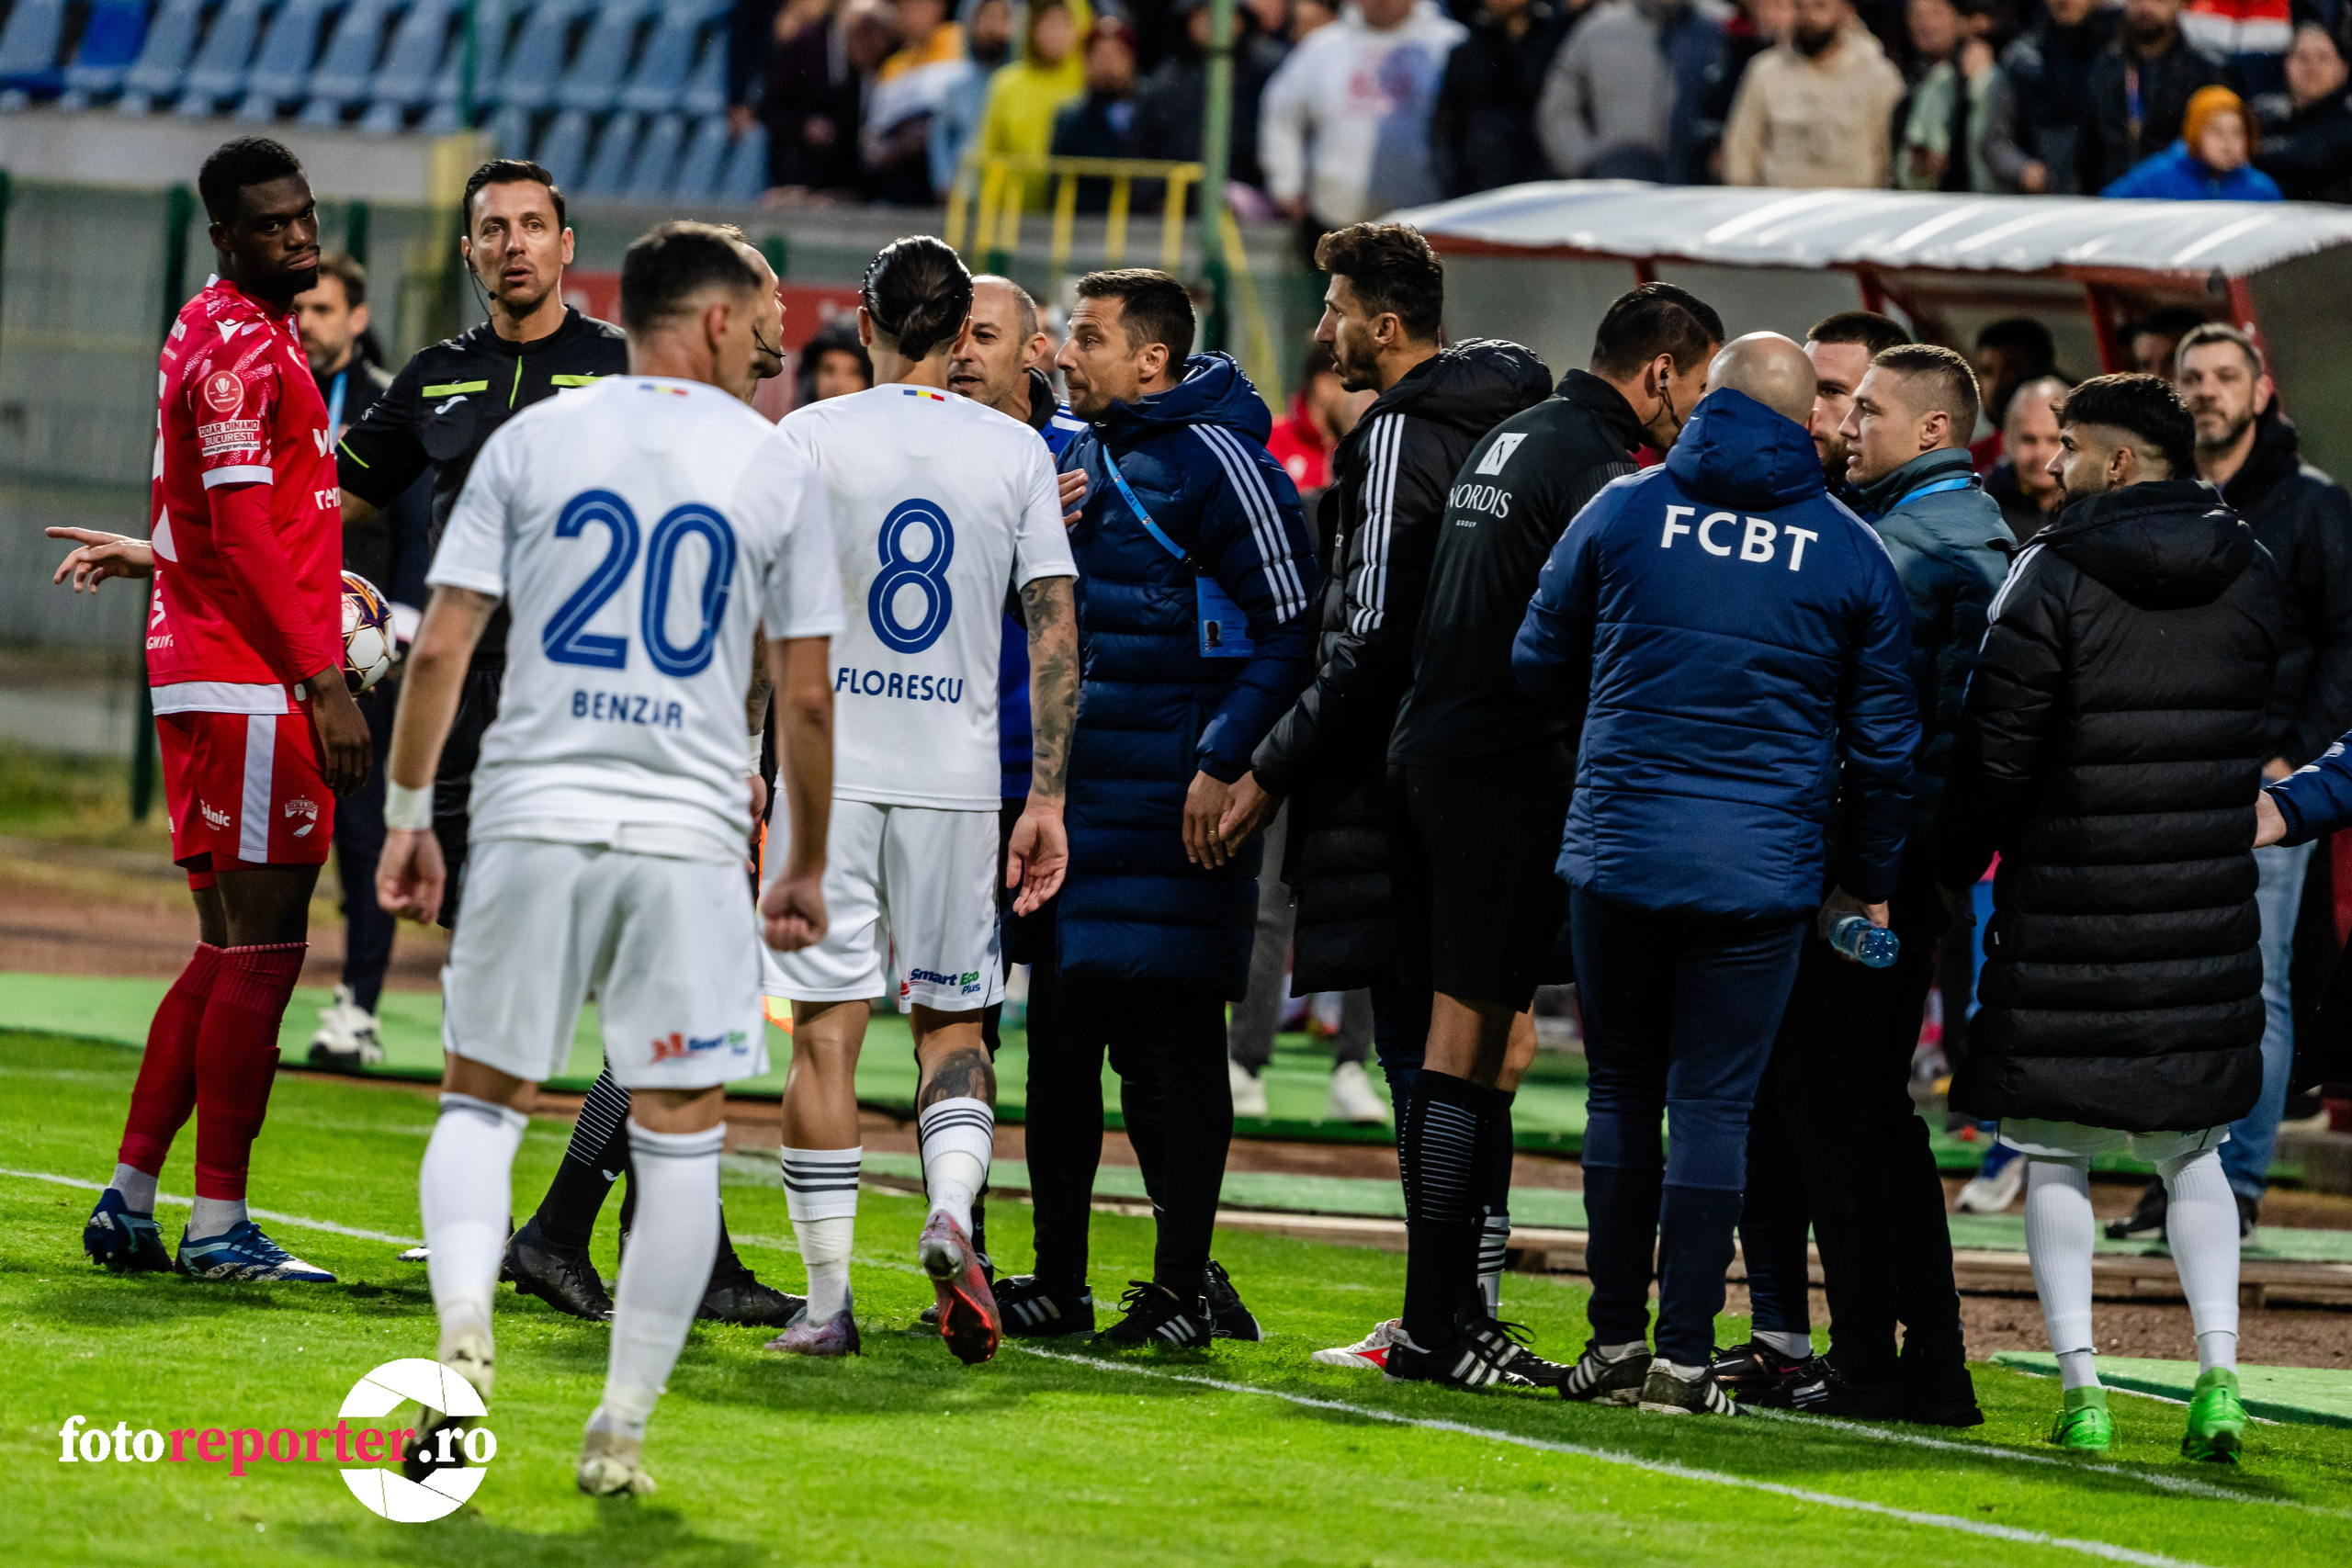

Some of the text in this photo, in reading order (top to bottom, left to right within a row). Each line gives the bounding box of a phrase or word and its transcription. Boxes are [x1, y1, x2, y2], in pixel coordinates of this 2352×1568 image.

[199, 421, 257, 436] DOAR DINAMO
[205, 432, 254, 446] BUCURESTI
[1456, 519, 1477, 528] GROUP
[1660, 504, 1819, 571] FCBT
[542, 486, 736, 678] 20
[868, 498, 955, 654] 8
[835, 667, 963, 704] FLORESCU
[571, 691, 683, 729] BENZAR
[910, 968, 979, 987] Smart Eco
[961, 983, 981, 995] Plus
